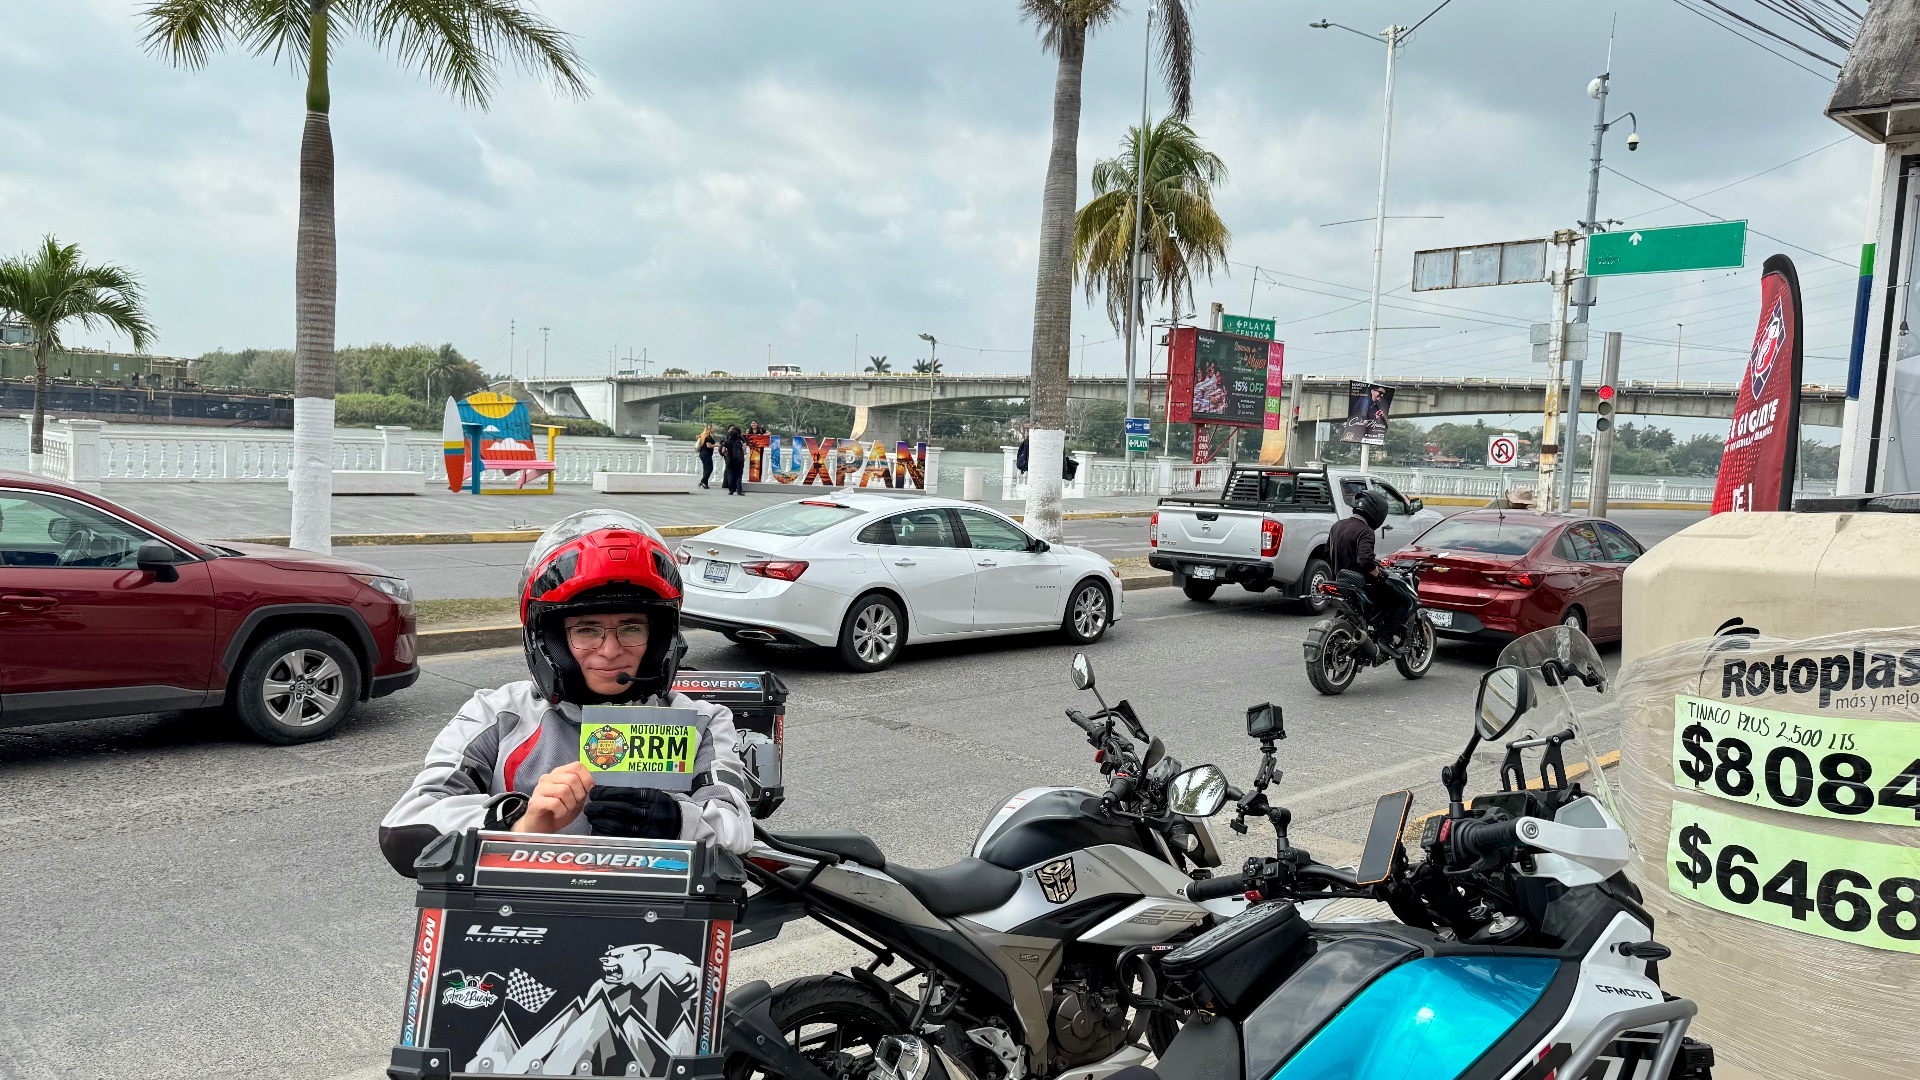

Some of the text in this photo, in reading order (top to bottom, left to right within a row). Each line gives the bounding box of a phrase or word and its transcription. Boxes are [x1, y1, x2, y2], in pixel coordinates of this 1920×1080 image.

[1236, 329, 1264, 339] CENTRO
[1243, 321, 1271, 331] PLAYA
[1249, 382, 1265, 393] OFF
[1134, 439, 1148, 448] PLAYA
[745, 433, 927, 489] TUXPAN
[1721, 644, 1920, 709] Rotoplas
[1835, 693, 1866, 709] más
[1869, 695, 1878, 712] y
[630, 724, 689, 736] MOTOTURISTA
[1687, 702, 1730, 725] TINACO
[1737, 711, 1770, 737] PLUS
[1775, 722, 1823, 748] 2,500
[628, 735, 688, 760] RRM
[628, 760, 664, 772] MÉXICO
[1679, 721, 1920, 820] $8,084
[509, 849, 662, 869] DISCOVERY
[1675, 822, 1920, 941] $6468
[464, 936, 544, 945] ALUCASE
[466, 924, 549, 938] LS2
[419, 916, 436, 984] MOTO
[712, 928, 726, 993] MOTO
[1595, 984, 1653, 1000] CFMOTO
[405, 984, 419, 1043] RACING
[701, 994, 713, 1051] RACING
